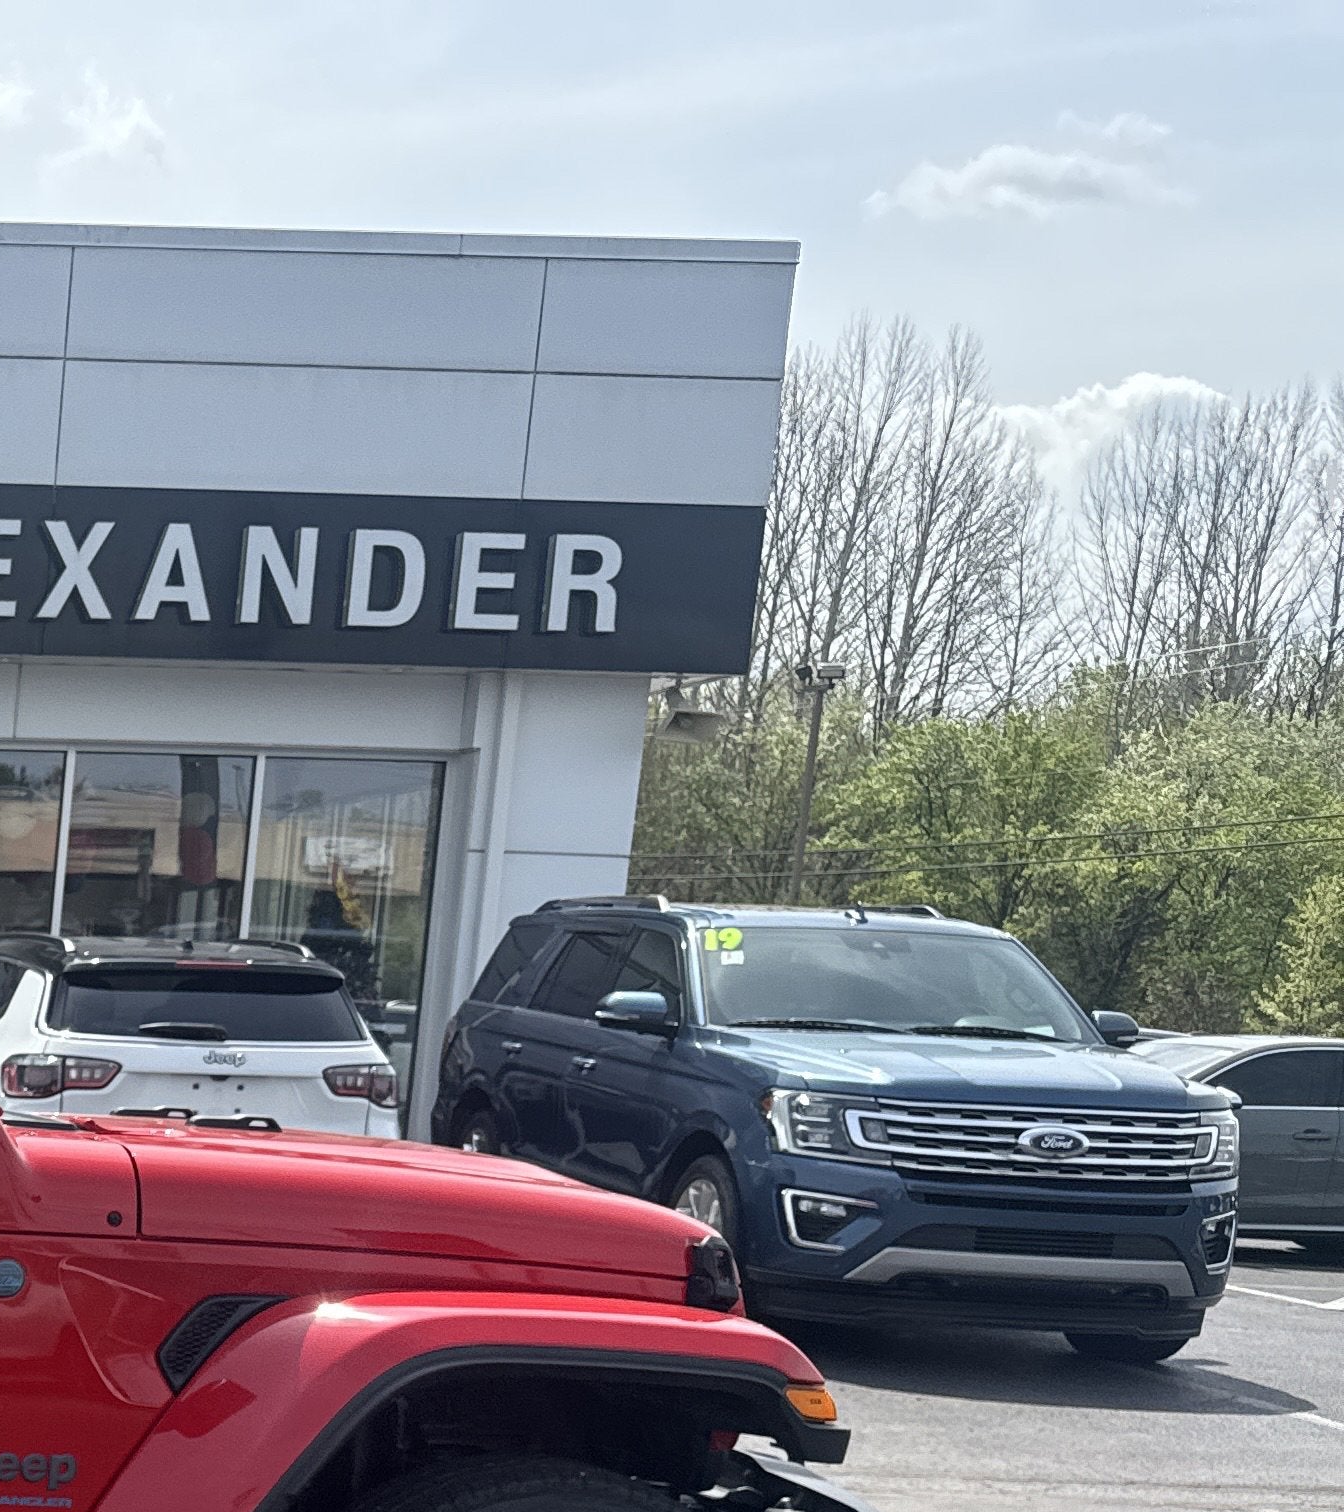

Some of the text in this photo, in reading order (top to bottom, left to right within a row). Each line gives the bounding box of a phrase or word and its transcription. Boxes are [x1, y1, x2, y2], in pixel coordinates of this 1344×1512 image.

[704, 927, 744, 952] 19
[202, 1050, 247, 1068] Jeep
[1040, 1135, 1074, 1149] Ford
